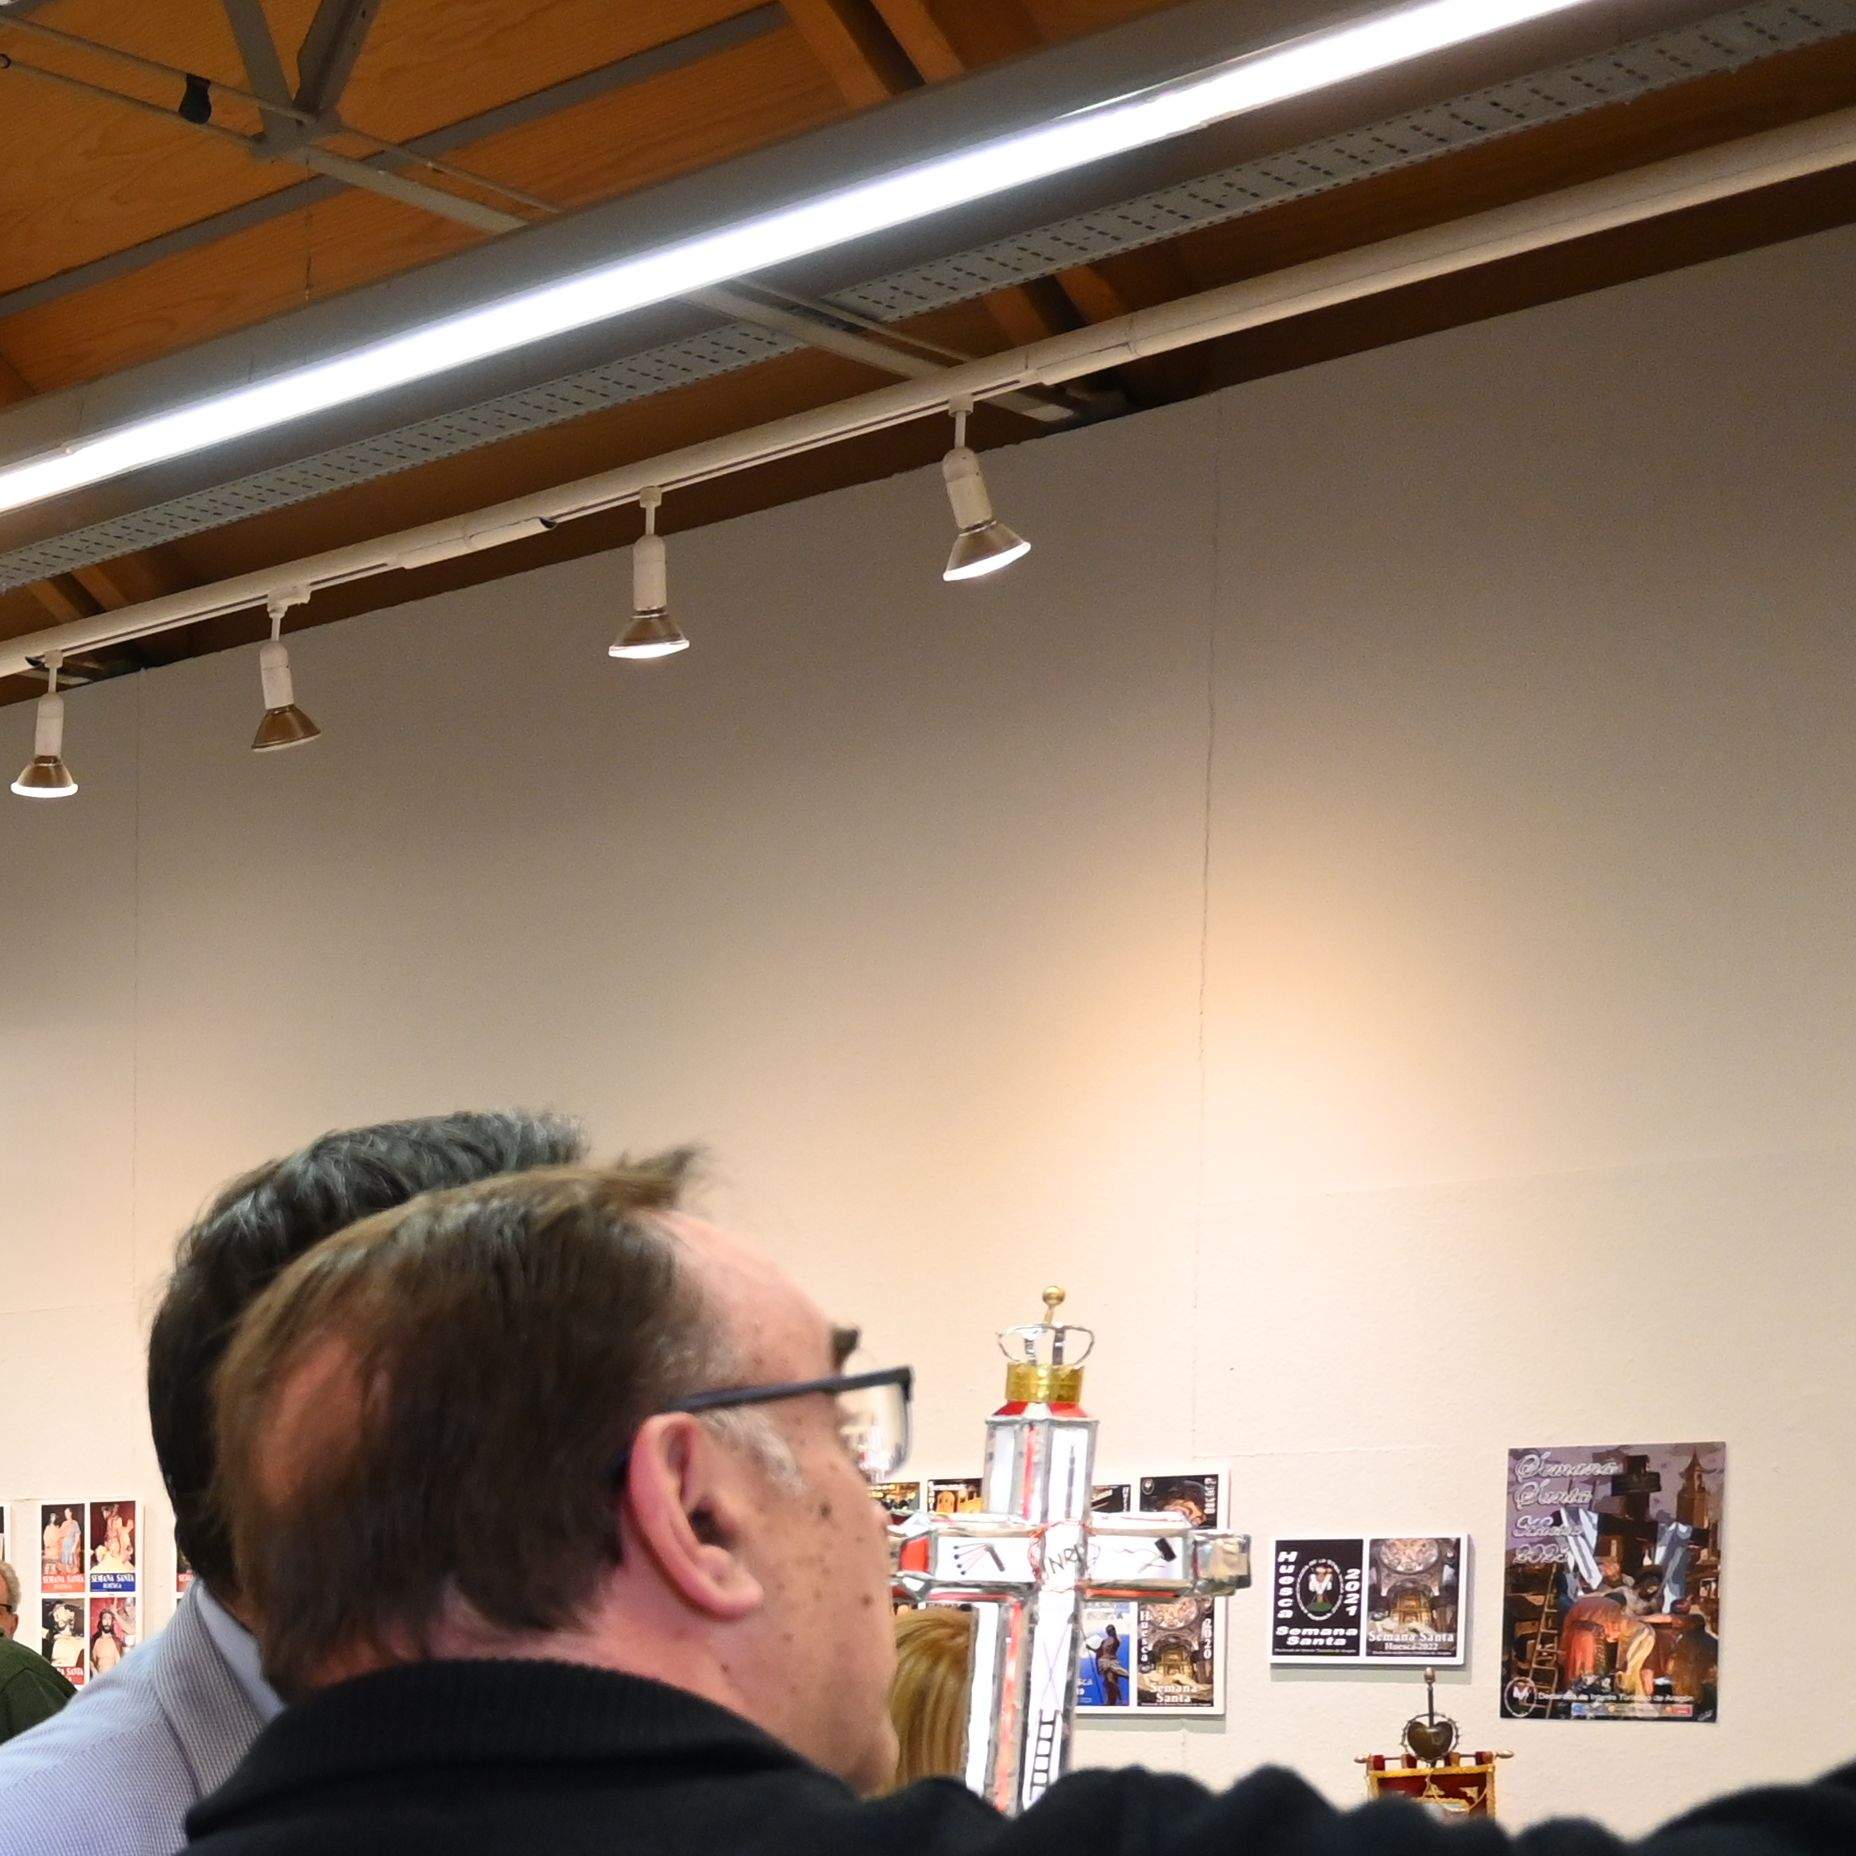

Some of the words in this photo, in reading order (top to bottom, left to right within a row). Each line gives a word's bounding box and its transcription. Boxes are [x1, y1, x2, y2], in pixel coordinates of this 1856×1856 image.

[1513, 1479, 1592, 1511] Santa
[1277, 1551, 1298, 1619] Huesca
[1343, 1568, 1361, 1617] 2021
[1274, 1626, 1358, 1636] Semana
[1368, 1631, 1415, 1642] Semana
[1420, 1631, 1454, 1642] Santa
[1202, 1618, 1213, 1659] 2020
[1286, 1635, 1347, 1646] Santa
[1415, 1642, 1438, 1651] 2022
[1151, 1685, 1198, 1693] Semana
[1156, 1693, 1192, 1703] Santa
